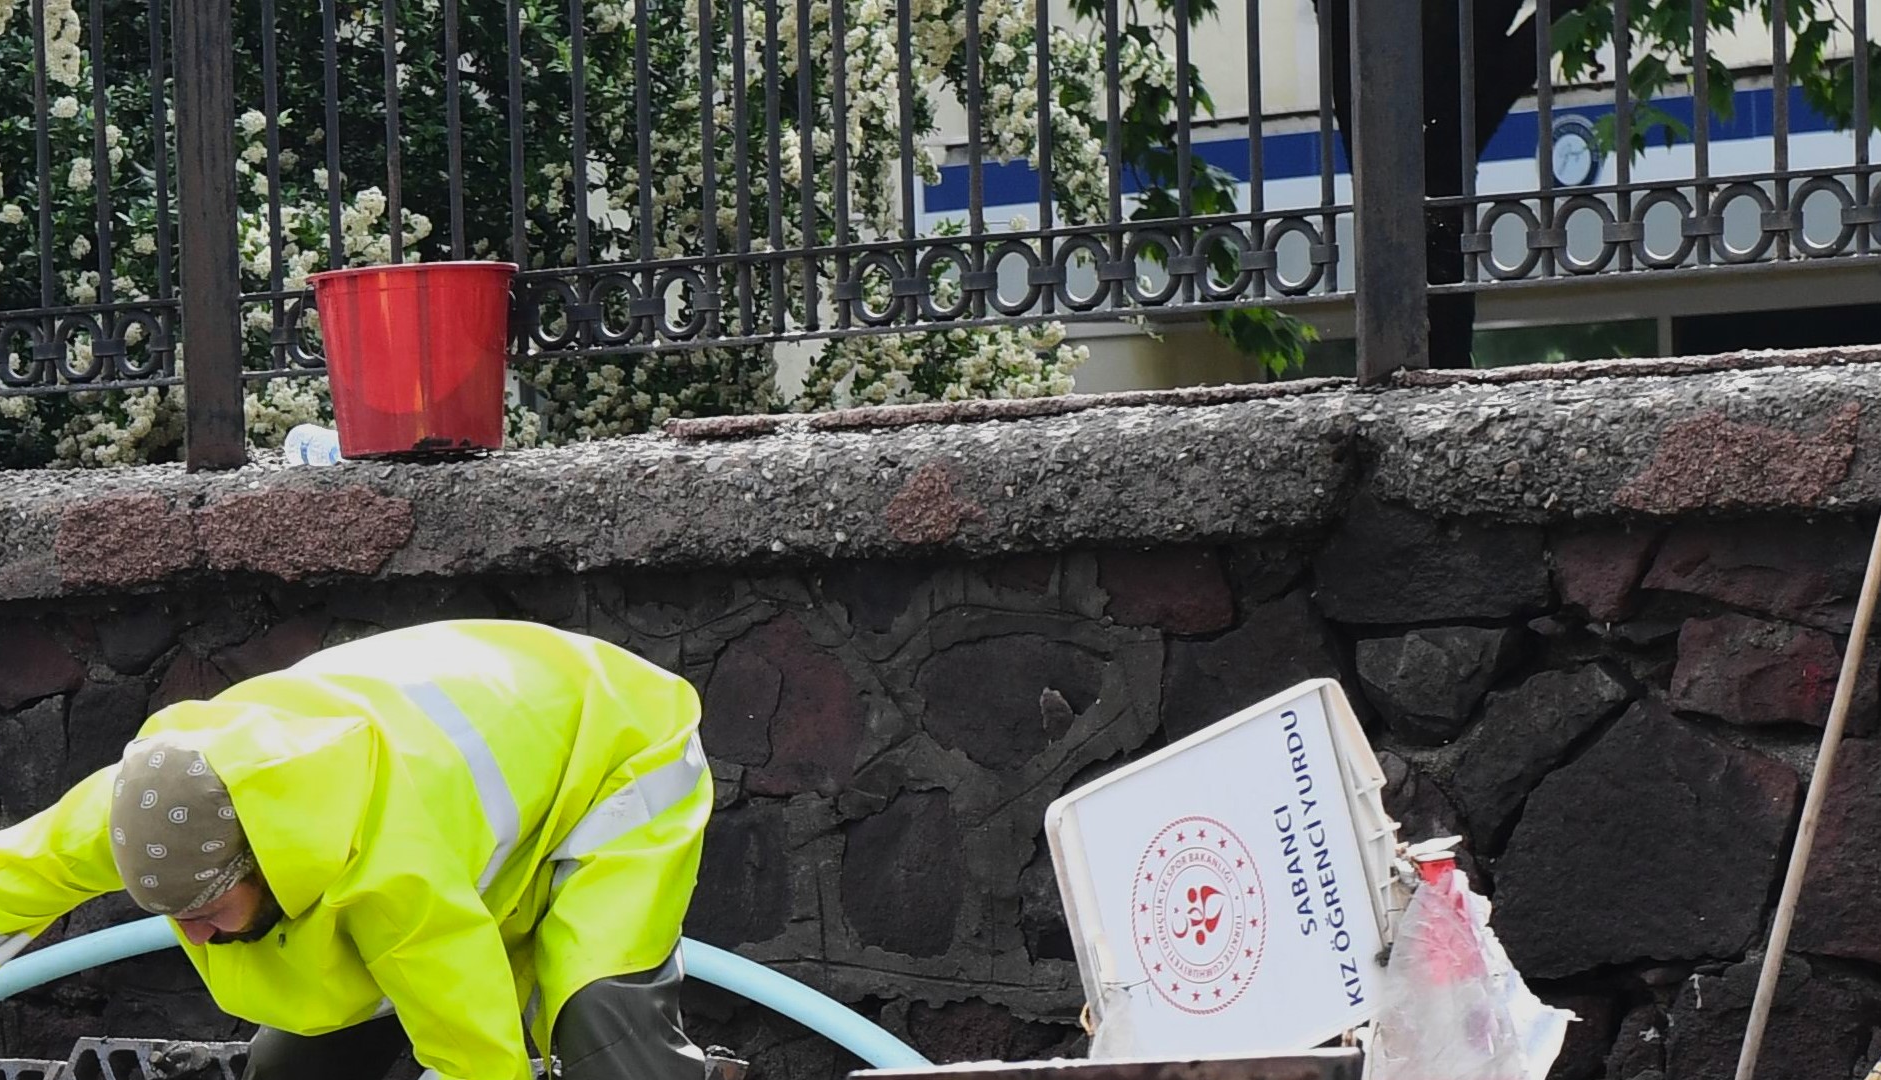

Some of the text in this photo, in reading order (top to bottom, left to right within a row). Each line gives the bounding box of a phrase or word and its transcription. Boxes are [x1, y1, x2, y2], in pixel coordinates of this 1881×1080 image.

[1273, 804, 1318, 936] SABANCI
[1280, 710, 1364, 1007] KIZ ÖĞRENCİ YURDU
